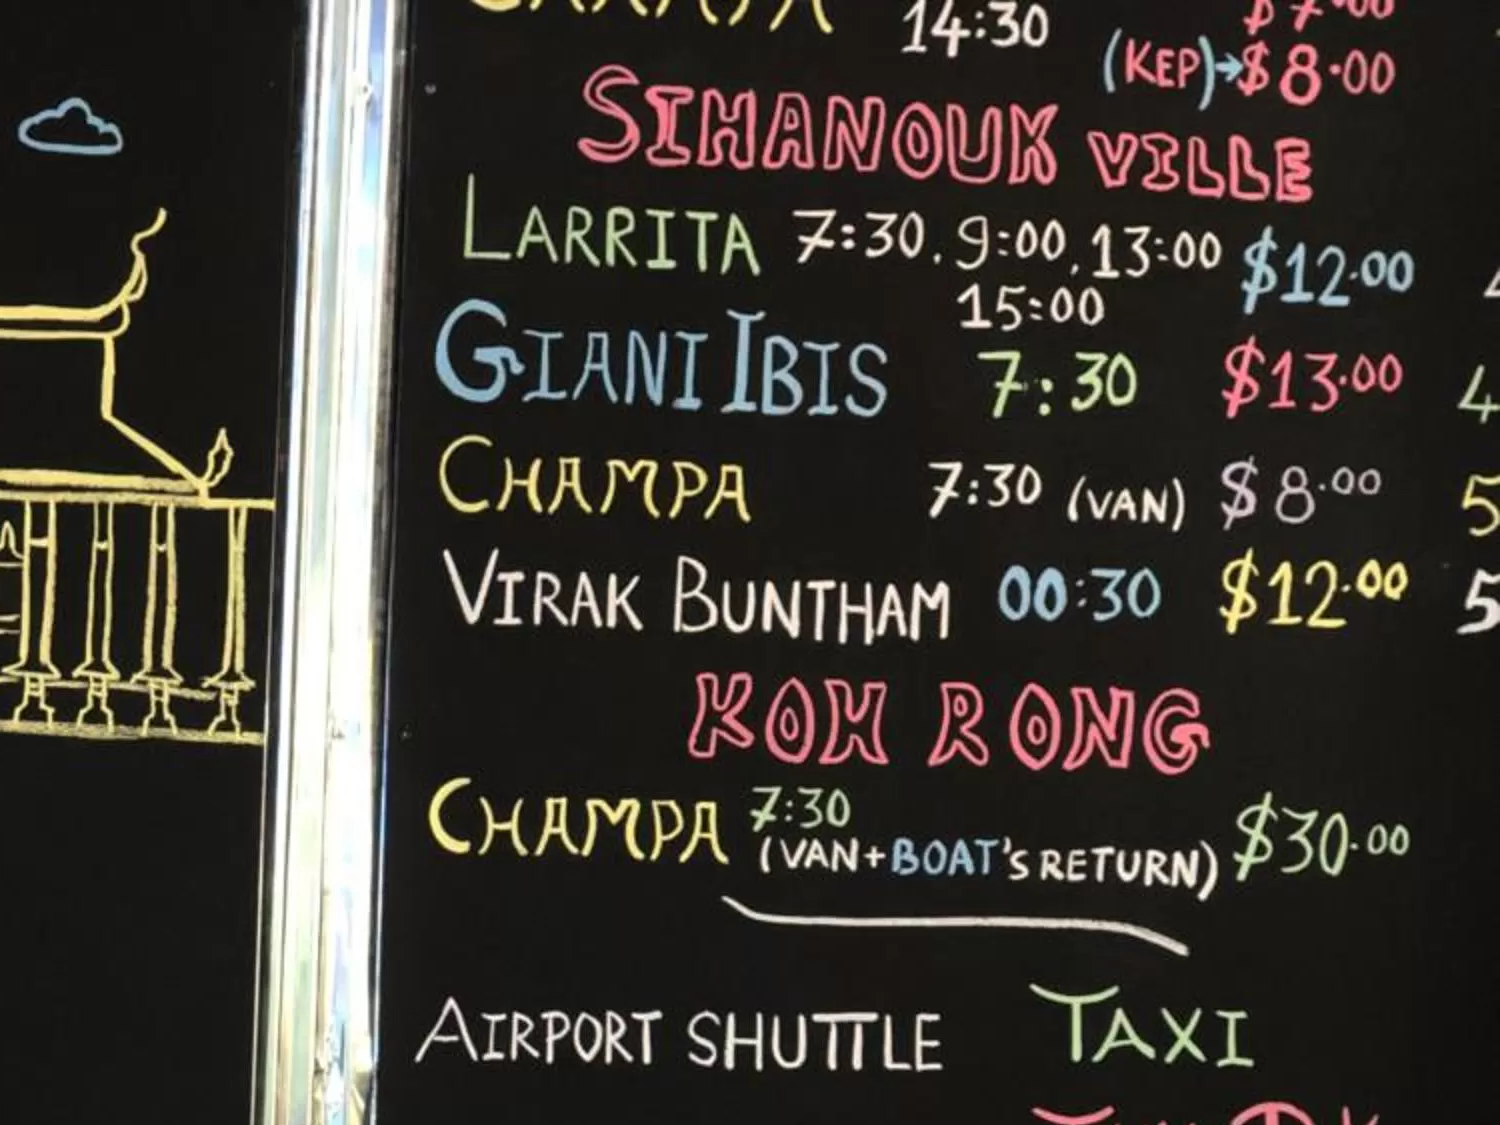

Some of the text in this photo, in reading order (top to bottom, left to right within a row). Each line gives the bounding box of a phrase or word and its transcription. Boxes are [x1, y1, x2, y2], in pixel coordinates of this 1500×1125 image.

[902, 0, 1048, 58] 14:30
[1104, 29, 1395, 110] (KEP) $8.00
[578, 64, 1313, 203] SIHANOUK VILLE
[464, 174, 760, 275] LARRITA
[957, 283, 1104, 331] 15:00
[721, 310, 887, 417] IBIS
[978, 351, 1137, 418] 7:30
[439, 435, 751, 522] CHAMPA
[929, 462, 1042, 518] 7:30
[1068, 476, 1185, 532] (VAN)
[443, 548, 643, 631] VIRAK
[674, 556, 949, 645] BUNTHAM
[999, 565, 1160, 621] 00:30
[688, 672, 1210, 775] KOH RONG
[429, 778, 729, 864] CHAMPA
[750, 787, 850, 832] 7:30
[415, 997, 942, 1072] AIRPORT SHUTTLE
[1030, 984, 1254, 1067] TAXI
